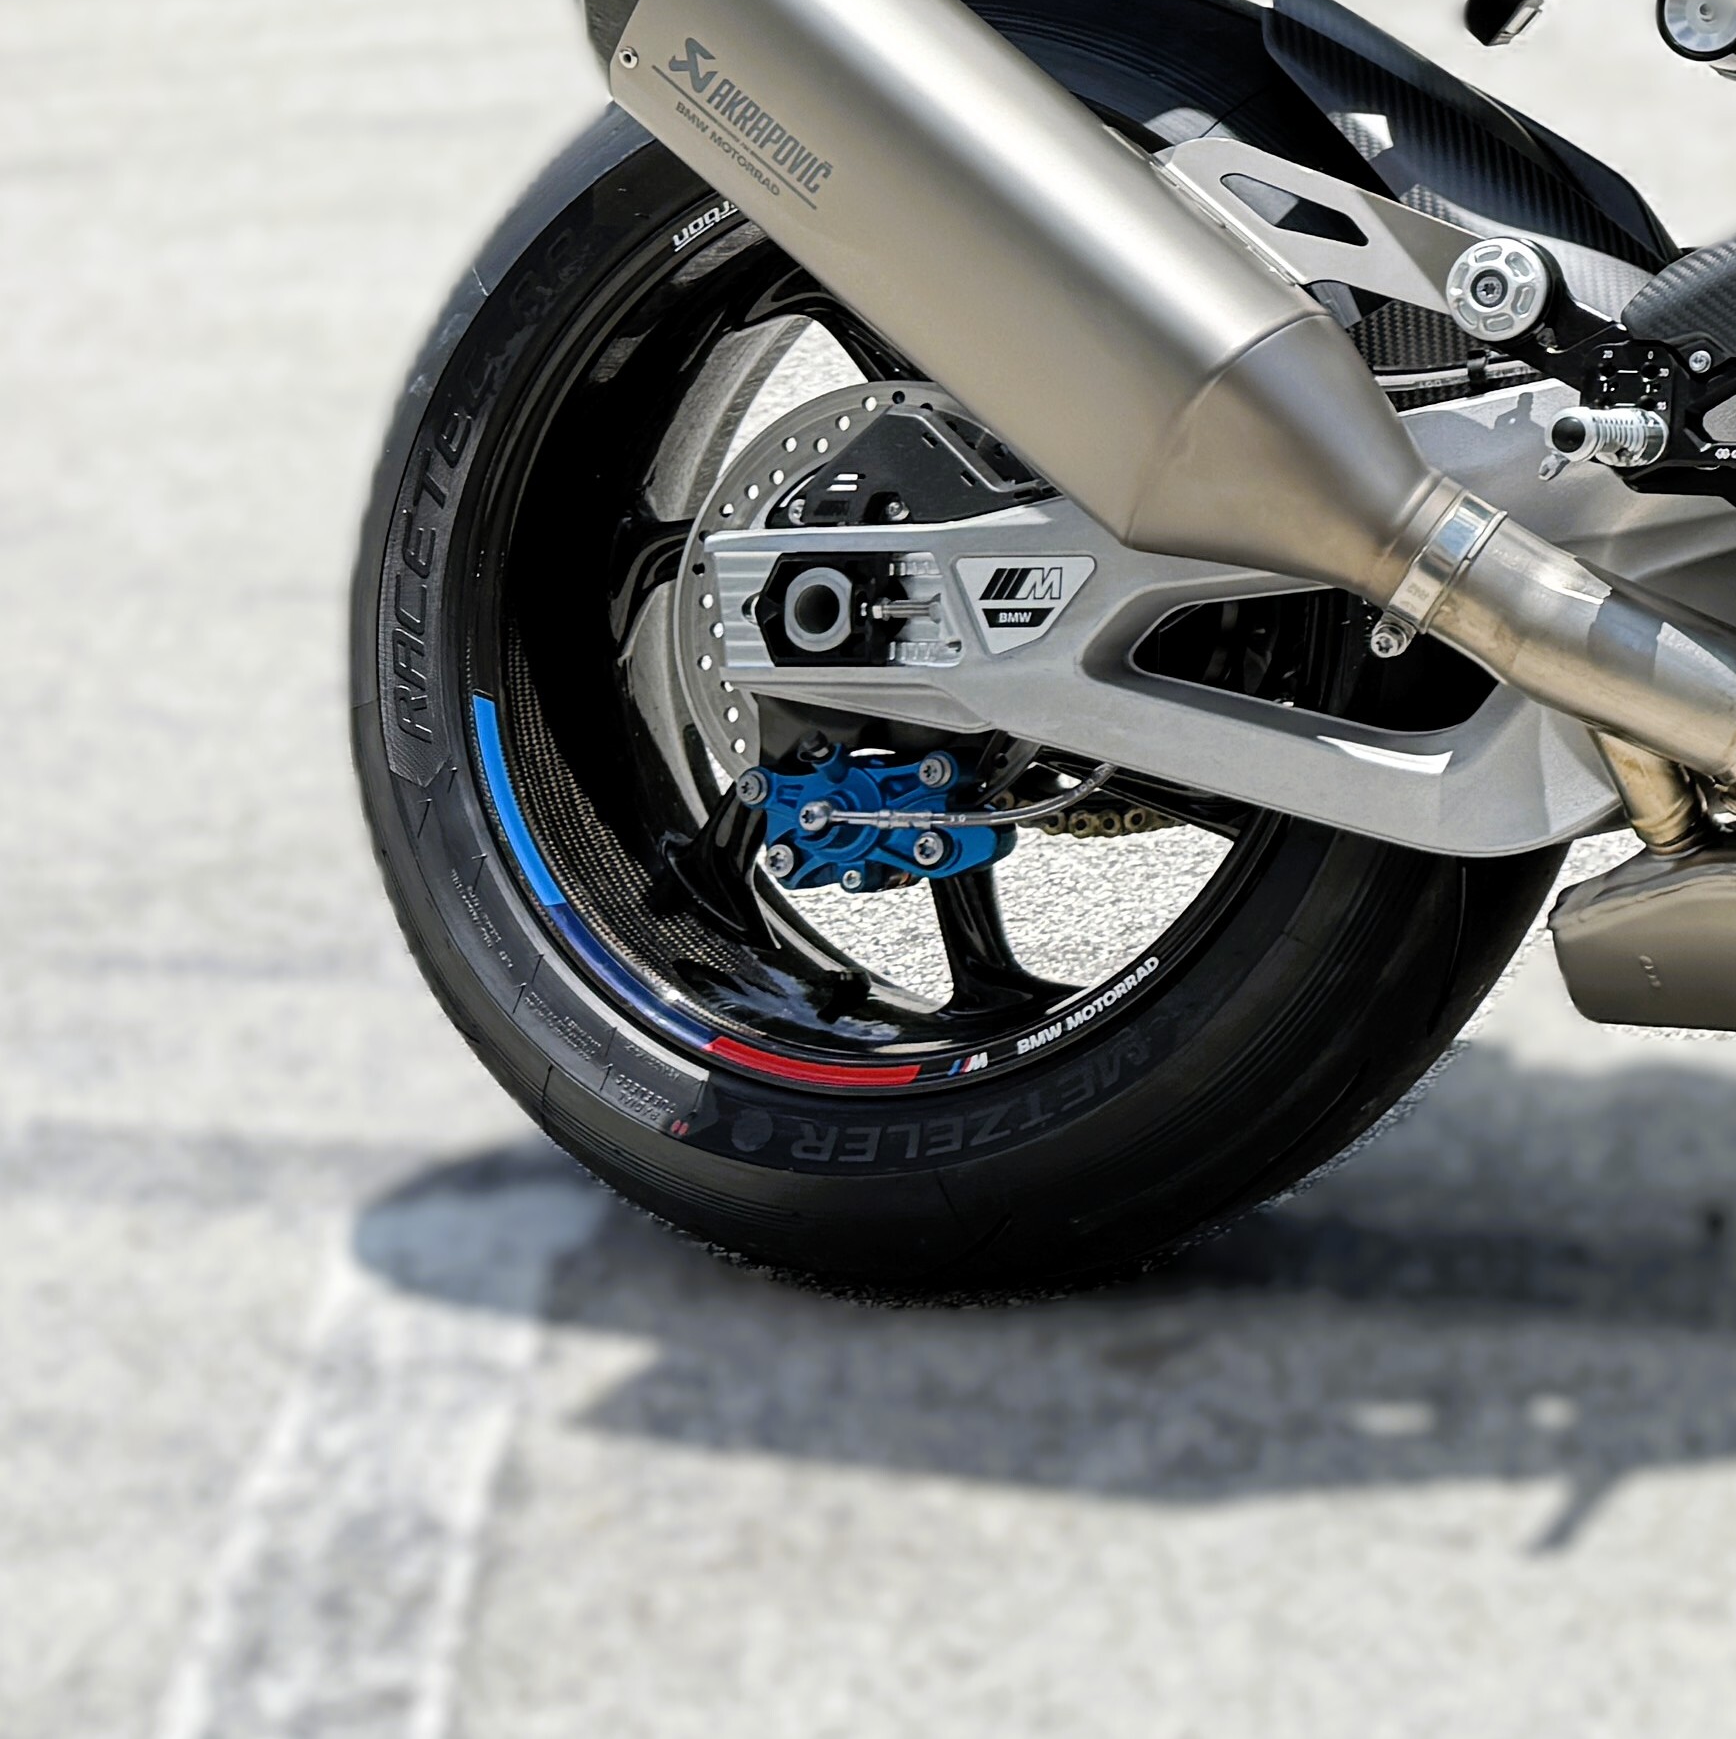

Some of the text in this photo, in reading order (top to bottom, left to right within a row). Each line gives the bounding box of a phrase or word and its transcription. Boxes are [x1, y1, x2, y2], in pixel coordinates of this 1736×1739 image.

[675, 101, 780, 197] BMW MOTORRAD
[706, 78, 834, 194] AKRAPOVIČ
[672, 200, 739, 252] rbon
[998, 612, 1032, 623] BMW
[1016, 1022, 1063, 1055] BMW
[1065, 956, 1160, 1031] MOTORRAD
